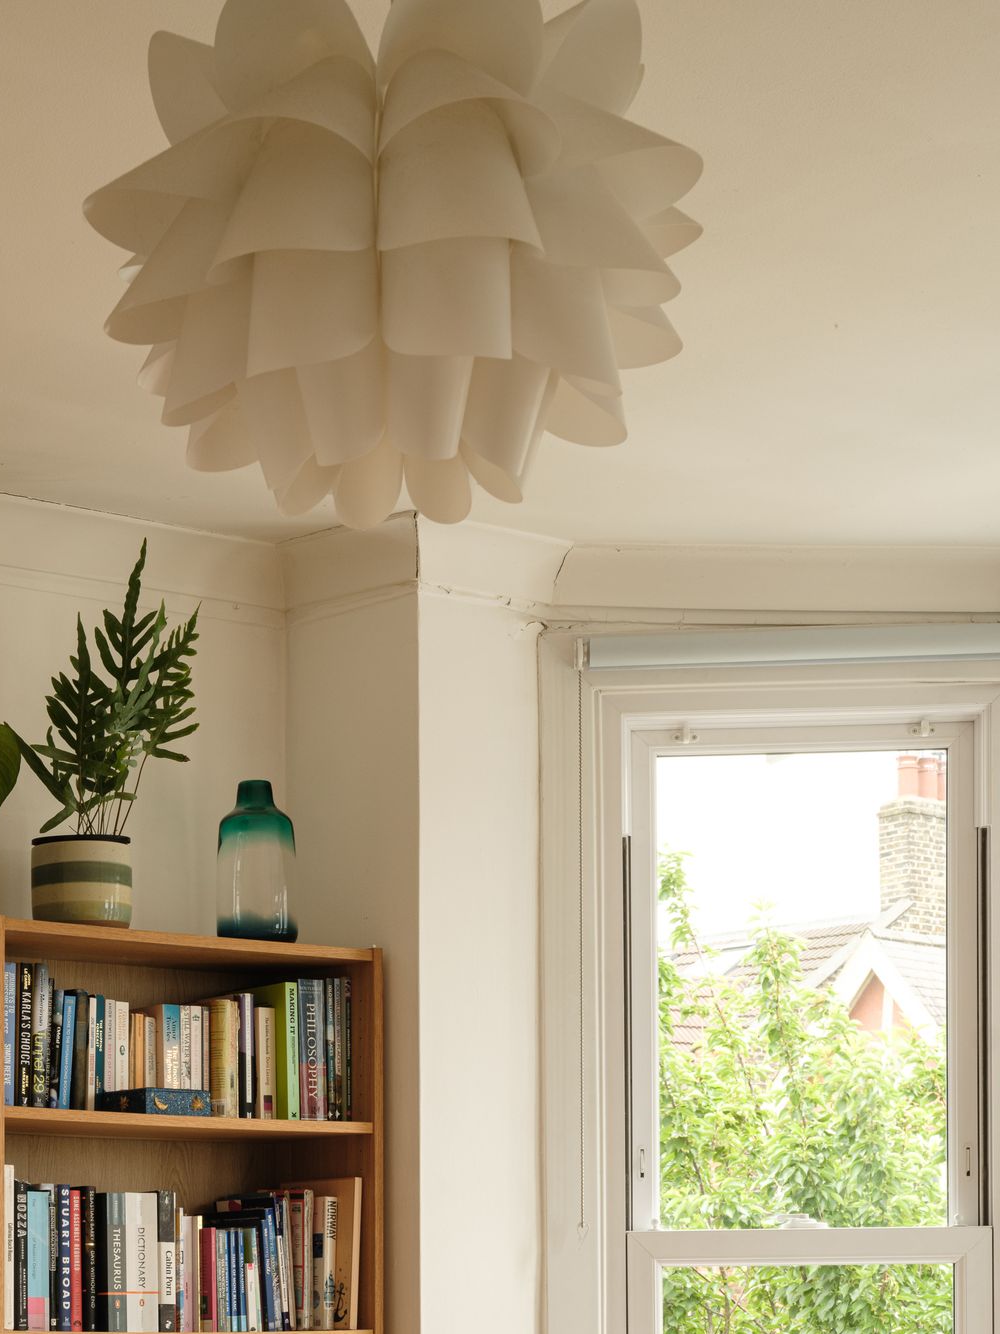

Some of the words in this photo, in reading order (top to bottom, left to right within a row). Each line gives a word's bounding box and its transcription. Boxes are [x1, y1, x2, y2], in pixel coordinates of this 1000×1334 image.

[20, 991, 32, 1029] KARLA'S
[289, 1025, 296, 1035] IT
[20, 1031, 31, 1065] CHOICE
[32, 1031, 47, 1072] Tunnel
[306, 1003, 318, 1099] PHILOSOPHY
[4, 1065, 12, 1086] REEVE
[33, 1074, 45, 1094] 29
[17, 1193, 27, 1238] MOZZA
[61, 1188, 70, 1248] STUART
[329, 1200, 337, 1241] NORWAY
[112, 1227, 122, 1290] THESAURUS
[137, 1227, 146, 1289] DICTIONARY
[165, 1250, 173, 1275] Cabin
[62, 1256, 71, 1311] BROAD
[165, 1276, 173, 1296] Porn
